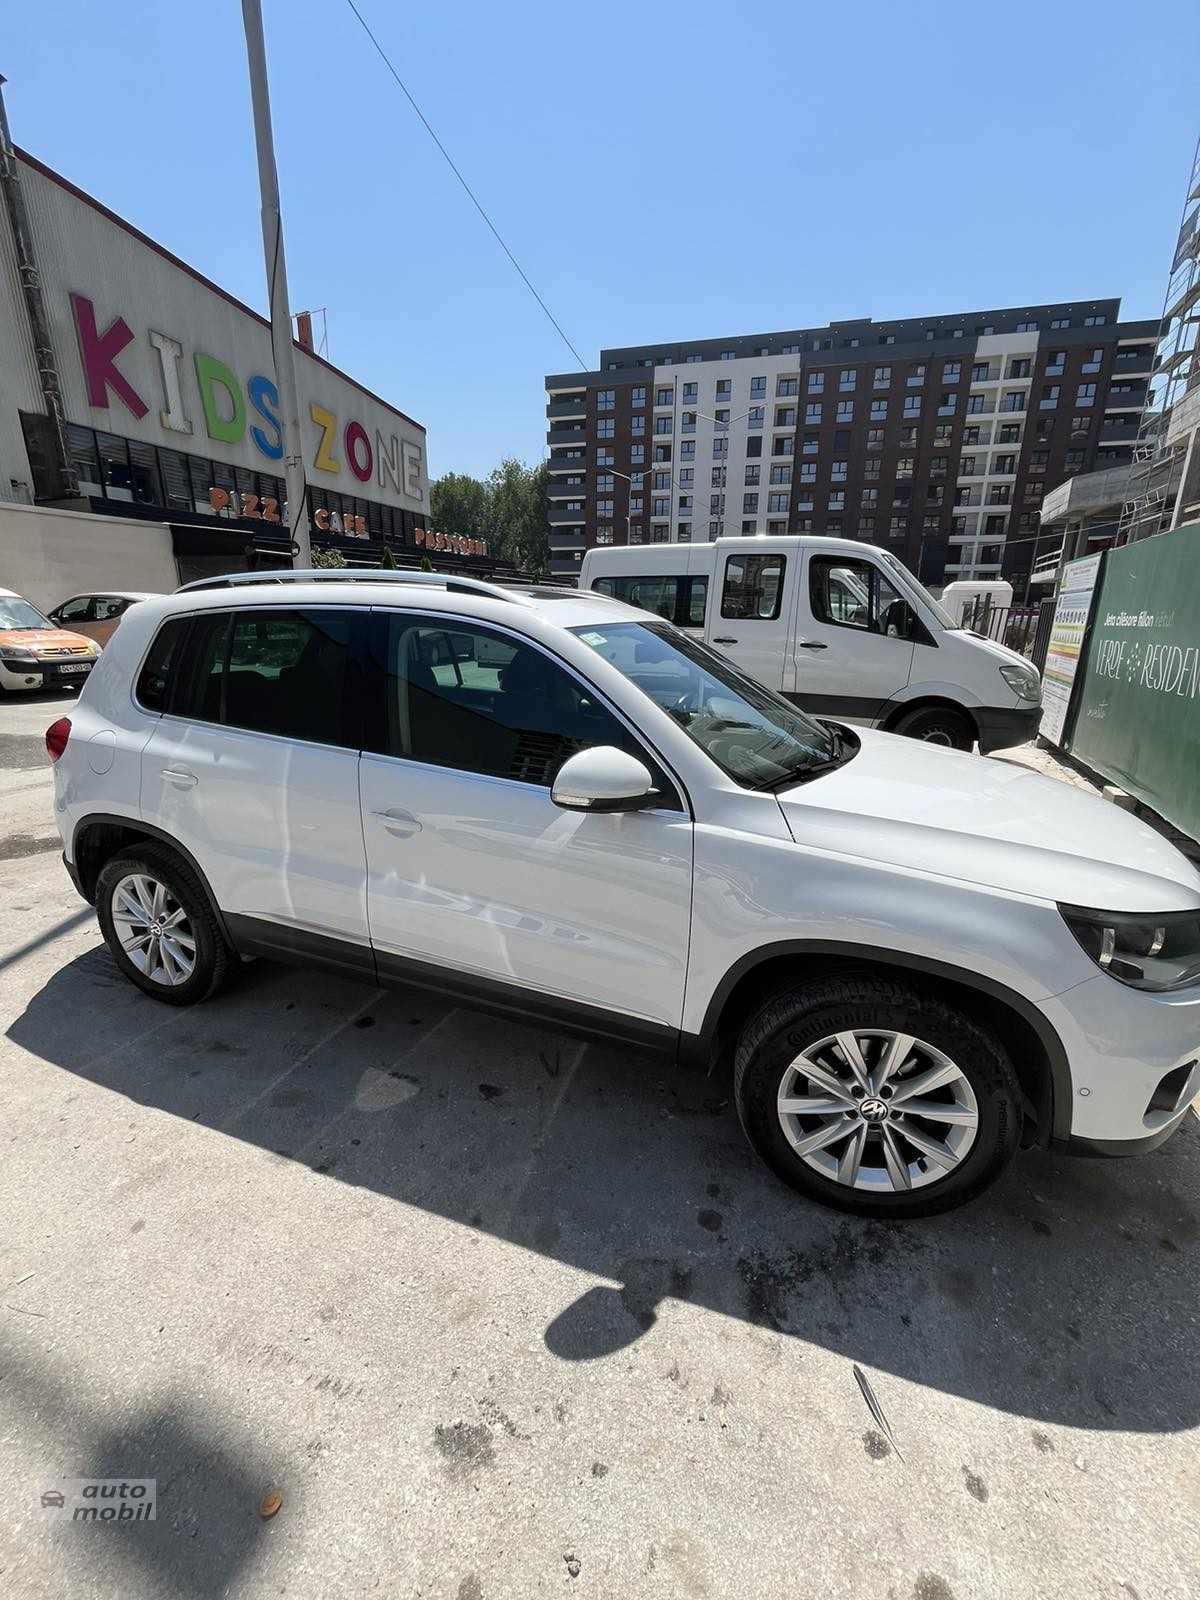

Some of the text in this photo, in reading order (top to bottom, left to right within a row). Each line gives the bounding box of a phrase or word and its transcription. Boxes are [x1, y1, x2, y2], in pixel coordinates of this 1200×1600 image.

[69, 293, 423, 501] KIDS ZONE
[314, 508, 370, 538] CAFE
[1140, 643, 1200, 699] RESIDEN
